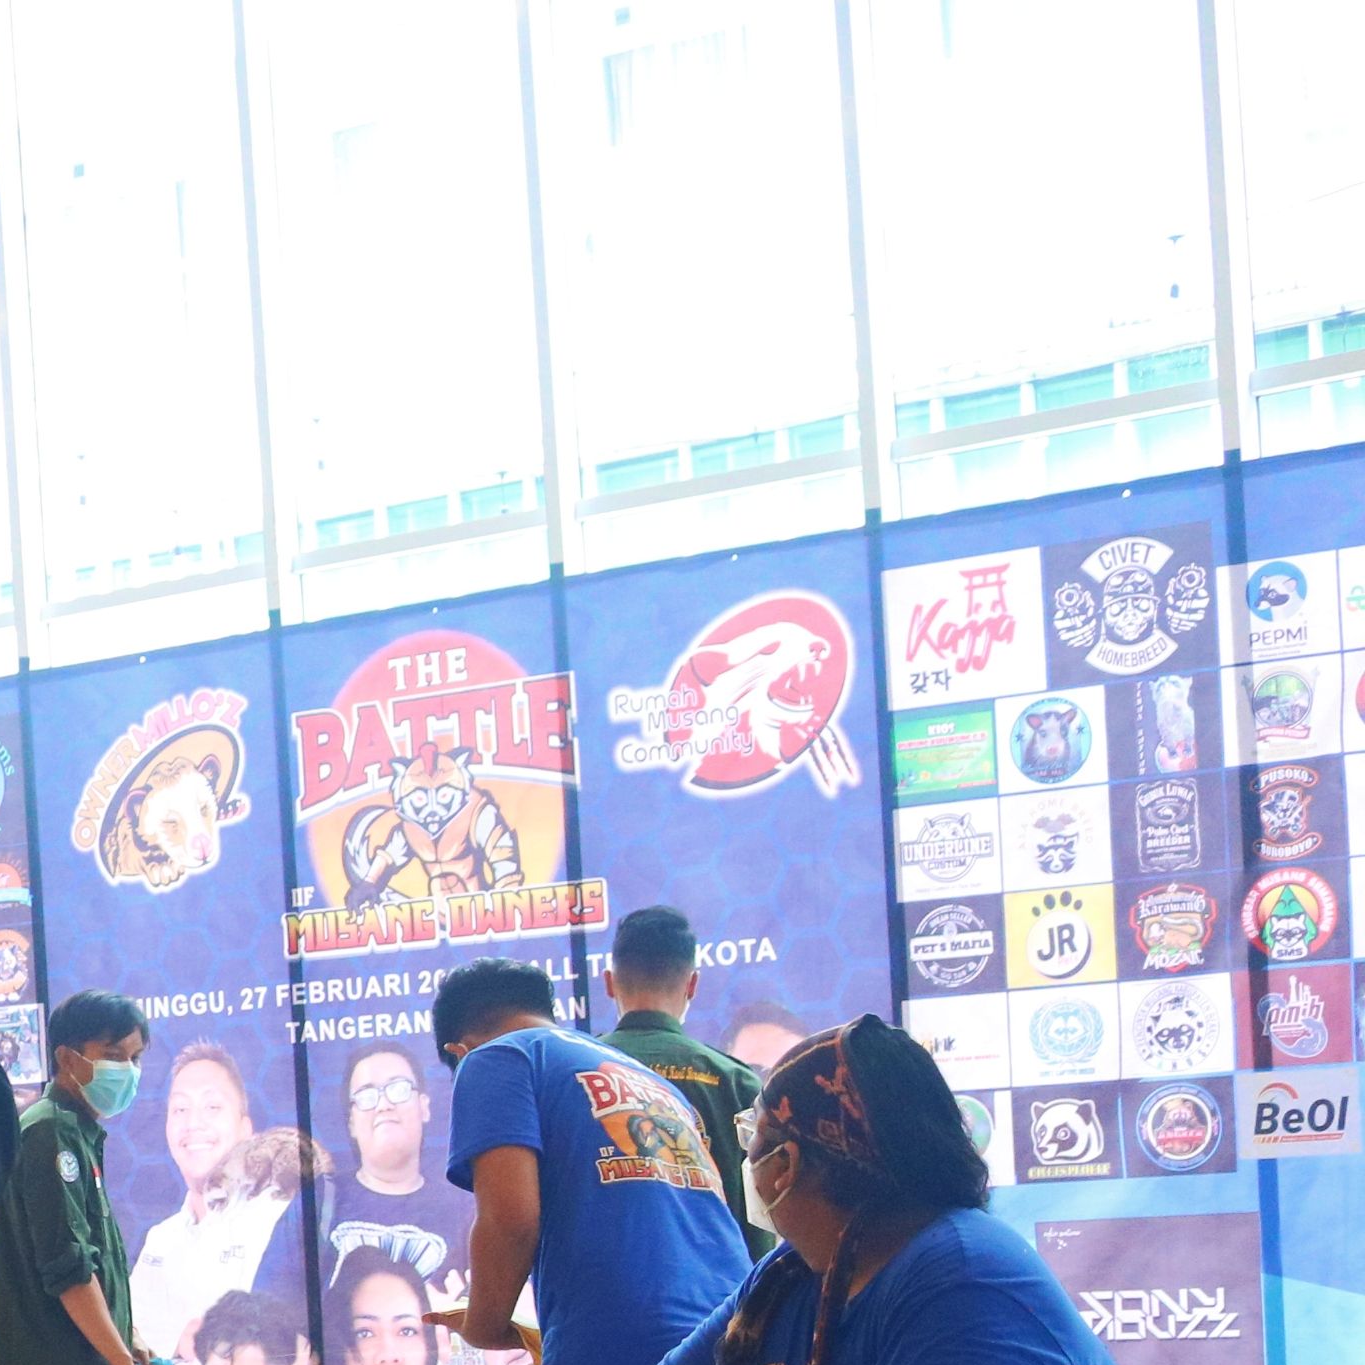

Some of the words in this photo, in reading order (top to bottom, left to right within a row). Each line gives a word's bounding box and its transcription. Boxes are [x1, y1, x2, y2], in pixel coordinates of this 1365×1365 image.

[1098, 541, 1156, 570] CIVET
[388, 648, 468, 692] THE
[1096, 637, 1168, 668] HOMEBREED
[614, 684, 696, 716] Rumah
[648, 706, 739, 733] Musang
[295, 678, 575, 810] BATTLE
[621, 730, 754, 765] Community
[903, 838, 992, 864] UNDERLINE
[284, 899, 436, 957] MUSANG
[447, 880, 604, 940] OWNERS
[1037, 923, 1077, 961] JR
[239, 986, 267, 1011] 27
[275, 971, 410, 1006] FEBRUARI
[695, 937, 778, 968] KOTA
[285, 1010, 431, 1045] TANGERAN
